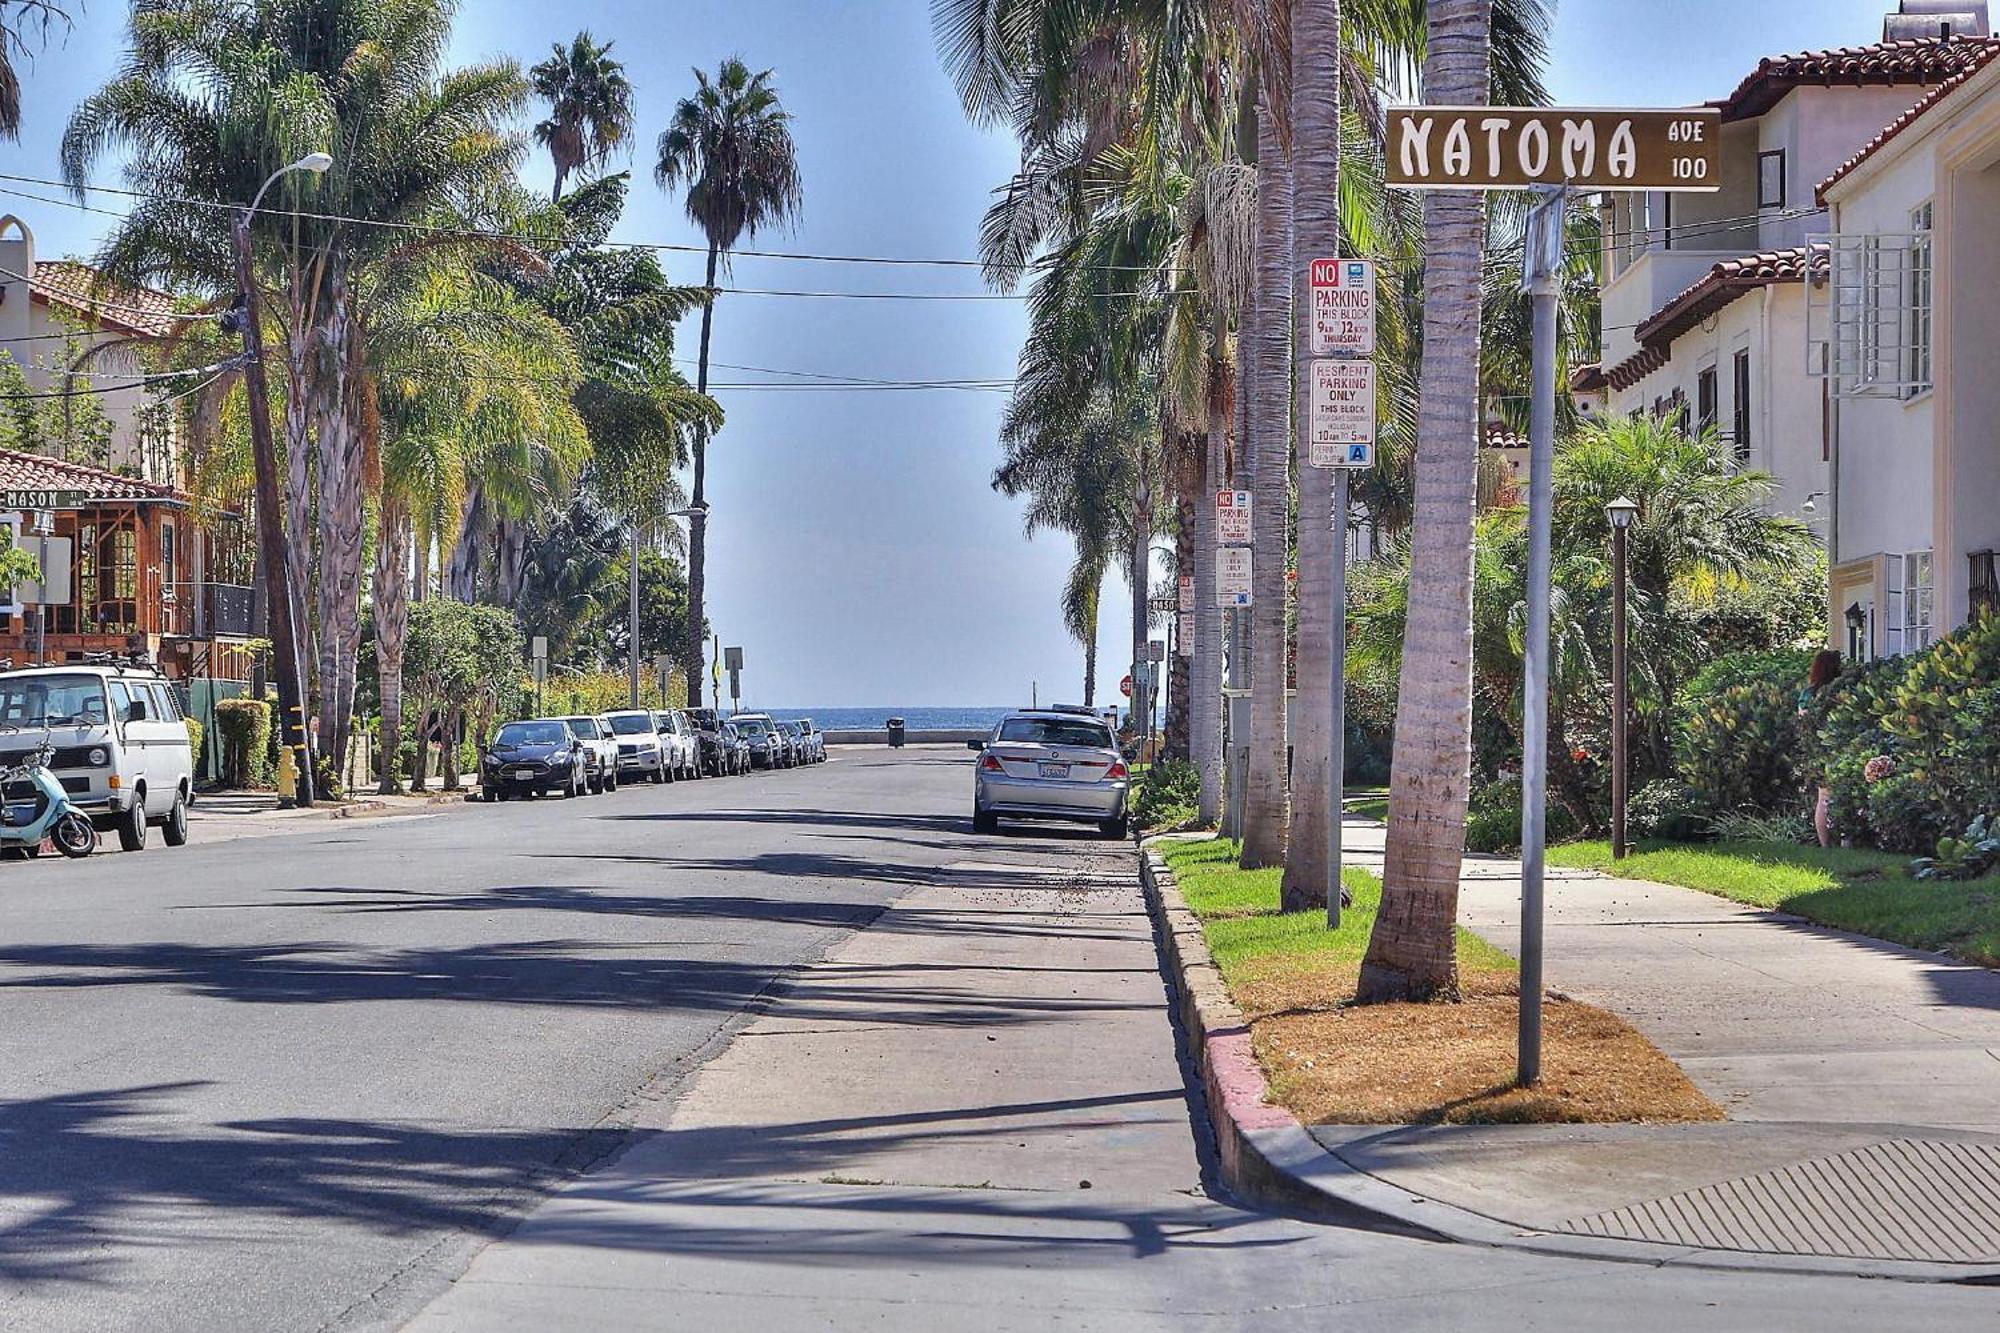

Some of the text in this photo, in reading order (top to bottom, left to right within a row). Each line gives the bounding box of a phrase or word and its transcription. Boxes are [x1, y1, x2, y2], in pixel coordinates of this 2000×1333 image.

[1401, 117, 1705, 178] NATOMA AVE
[1672, 158, 1707, 179] 100
[1315, 264, 1336, 283] NO
[1316, 290, 1369, 308] PARKING
[1317, 309, 1369, 319] THIS BLOCK
[1324, 335, 1362, 343] THURSDAY
[1316, 366, 1369, 376] RESIDENT
[1319, 379, 1366, 389] PARKING
[1329, 390, 1356, 401] ONLY
[1320, 405, 1365, 413] THIS BLOCK
[7, 491, 57, 507] MASON
[1219, 494, 1231, 505] NO
[1152, 600, 1174, 610] MASO
